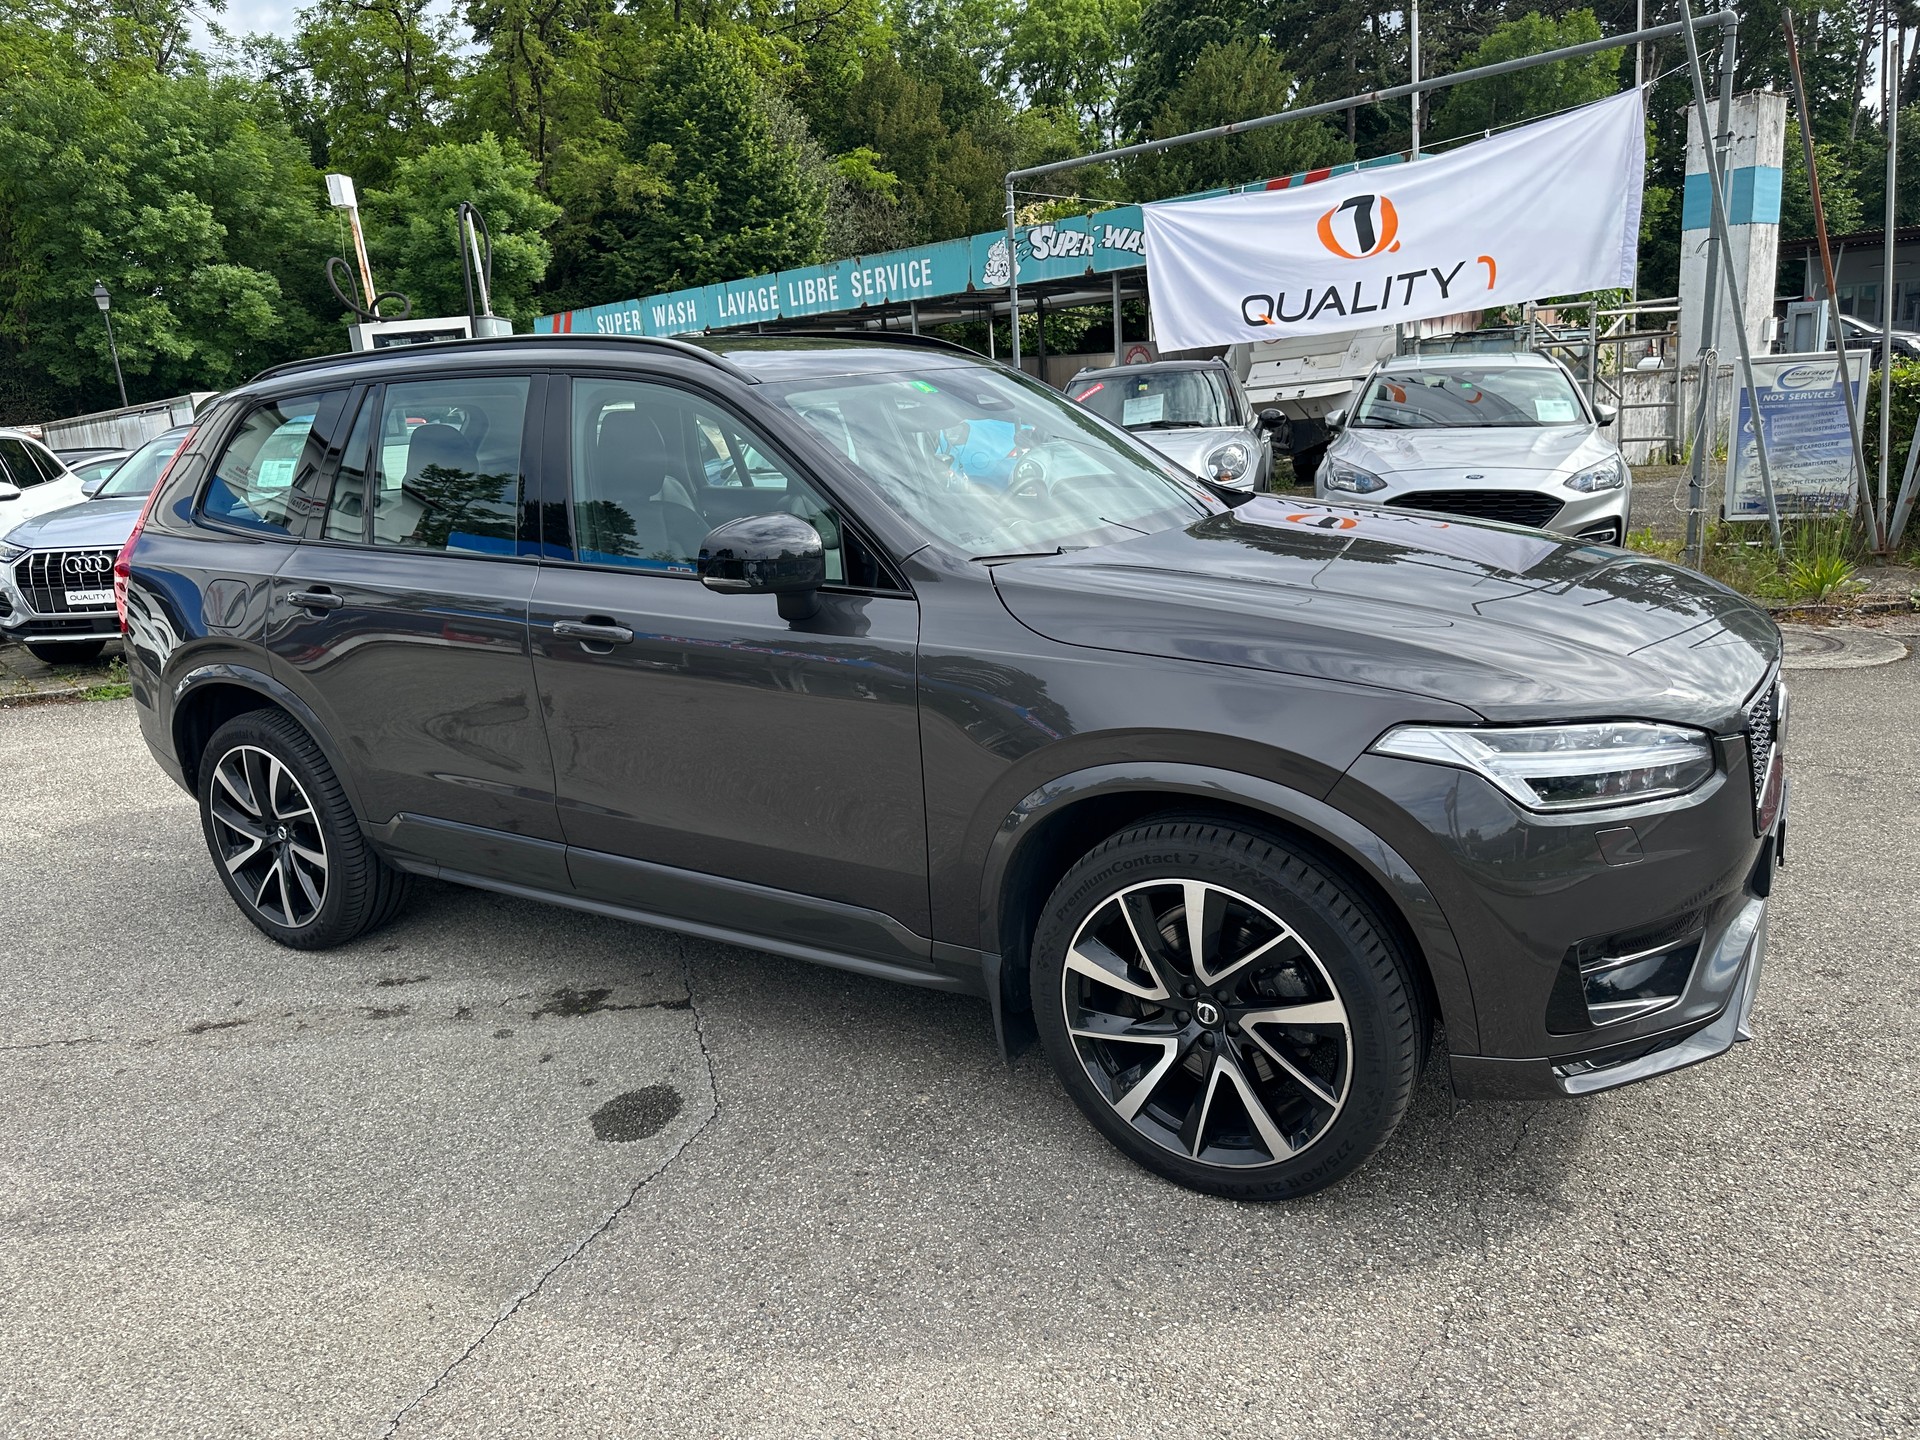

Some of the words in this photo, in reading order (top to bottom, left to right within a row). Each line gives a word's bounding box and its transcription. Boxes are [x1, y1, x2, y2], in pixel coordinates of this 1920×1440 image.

[1027, 224, 1095, 260] SUPER
[597, 309, 641, 334] SUPER
[652, 299, 697, 328] WASH
[717, 285, 779, 318] LAVAGE
[788, 275, 839, 307] LIBRE
[851, 258, 933, 298] SERVICE
[1241, 260, 1466, 327] QUALITY
[1791, 369, 1834, 377] Garage
[1762, 393, 1785, 402] NOS
[1788, 391, 1836, 401] SERVICES
[70, 593, 106, 601] QUALITY
[1056, 852, 1181, 921] PremiumContact
[1188, 853, 1200, 865] 7
